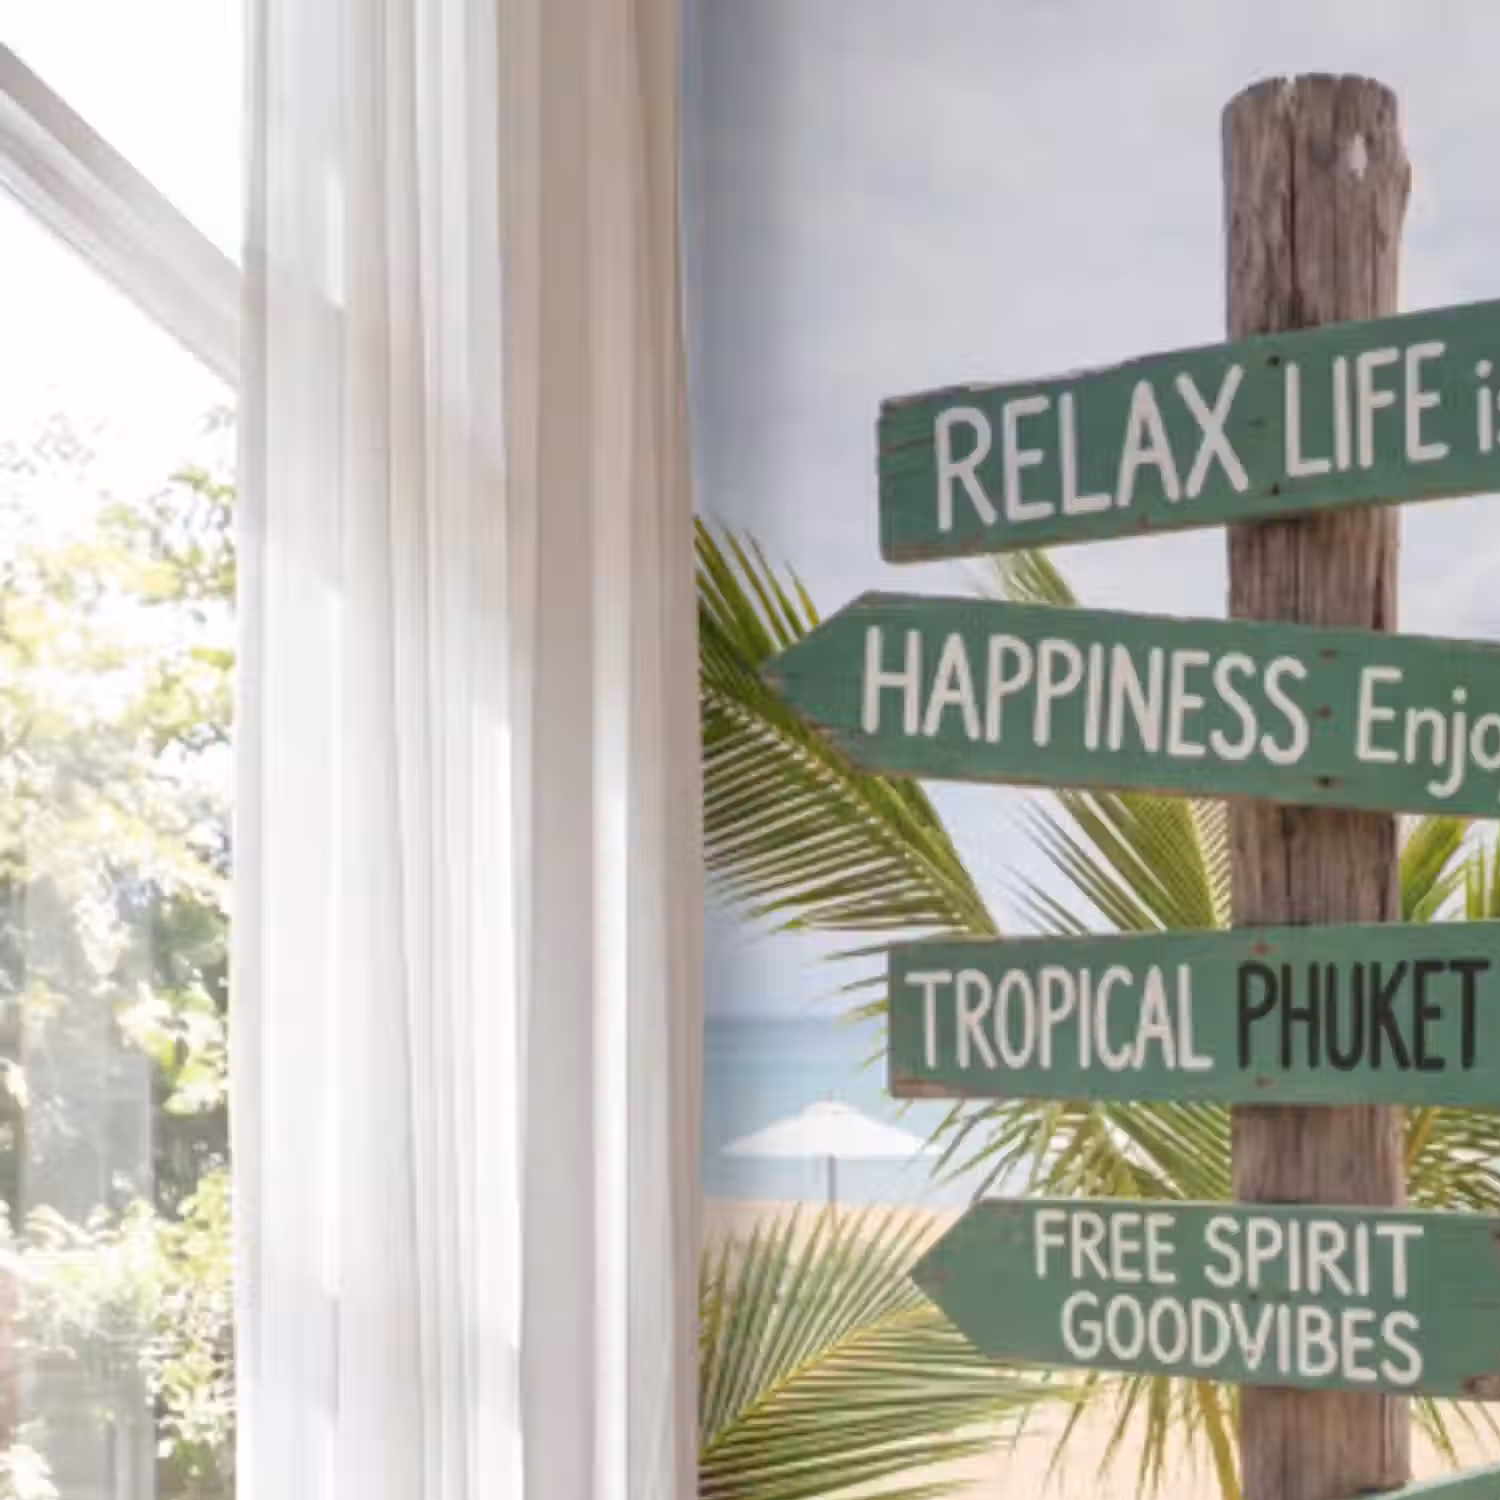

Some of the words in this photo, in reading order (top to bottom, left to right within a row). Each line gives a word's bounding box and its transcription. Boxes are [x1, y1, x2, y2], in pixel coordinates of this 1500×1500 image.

[936, 364, 1248, 532] RELAX
[1286, 342, 1449, 478] LIFE
[861, 625, 1310, 765] HAPPINESS
[905, 965, 1214, 1070] TROPICAL
[1237, 958, 1489, 1072] PHUKET
[1034, 1209, 1177, 1284] FREE
[1204, 1216, 1424, 1299] SPIRIT
[1061, 1292, 1424, 1386] GOODVIBES
